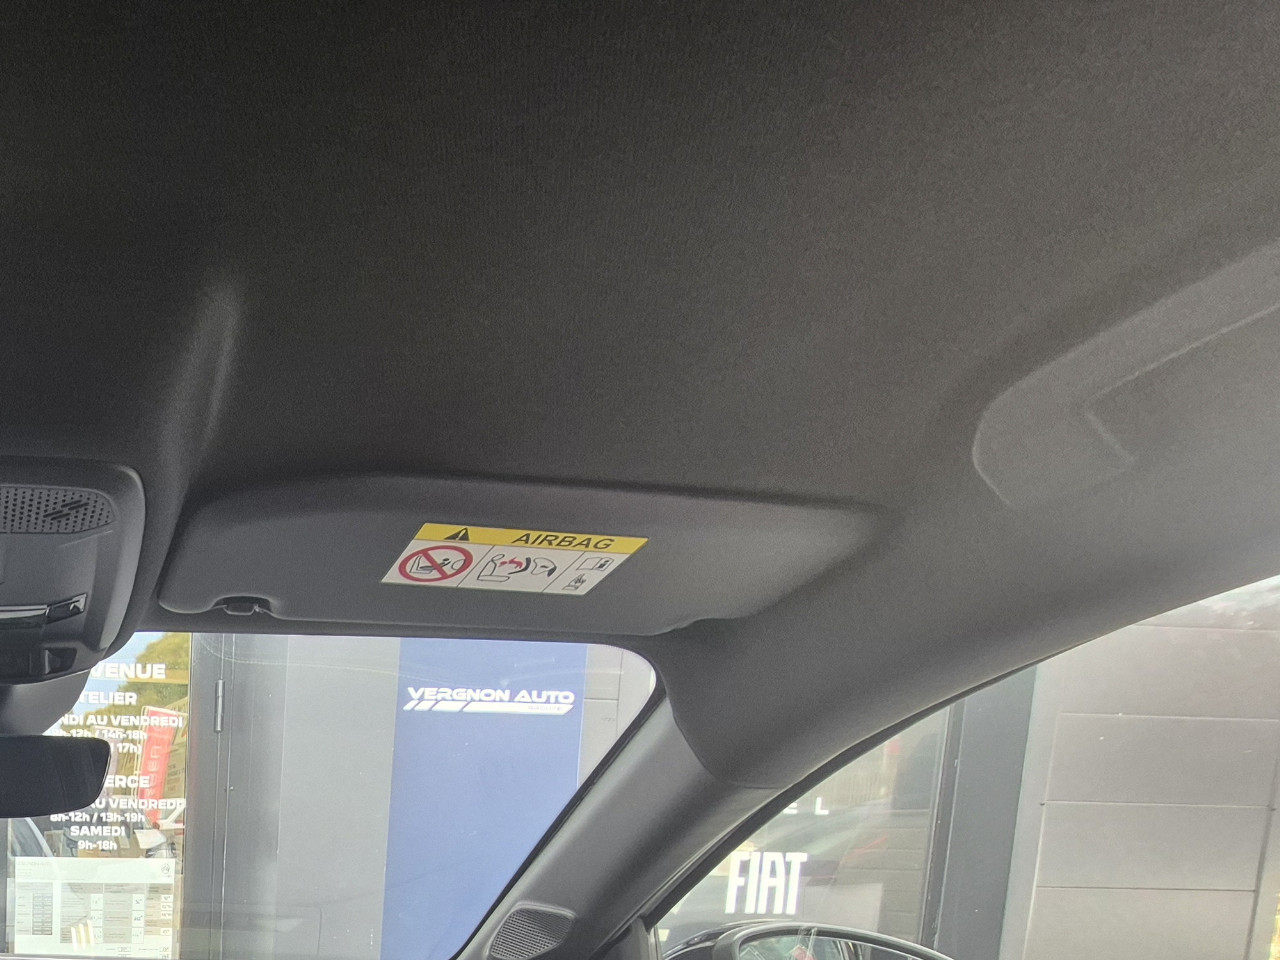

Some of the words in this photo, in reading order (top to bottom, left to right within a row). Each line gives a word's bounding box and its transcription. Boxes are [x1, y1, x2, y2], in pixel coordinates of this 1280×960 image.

[510, 532, 615, 550] AIRBAG
[90, 662, 166, 680] VENUE
[79, 690, 138, 706] TELIER
[407, 686, 511, 703] VERGNON
[513, 689, 575, 704] AUTO
[60, 714, 84, 726] NDI
[86, 714, 108, 726] AU
[110, 714, 184, 728] VENDREDI
[104, 775, 151, 788] ERCE
[100, 812, 146, 823] 13h-19h
[70, 825, 126, 837] SAMEDI
[77, 840, 118, 851] 9h-18h
[724, 851, 808, 915] FIAT
